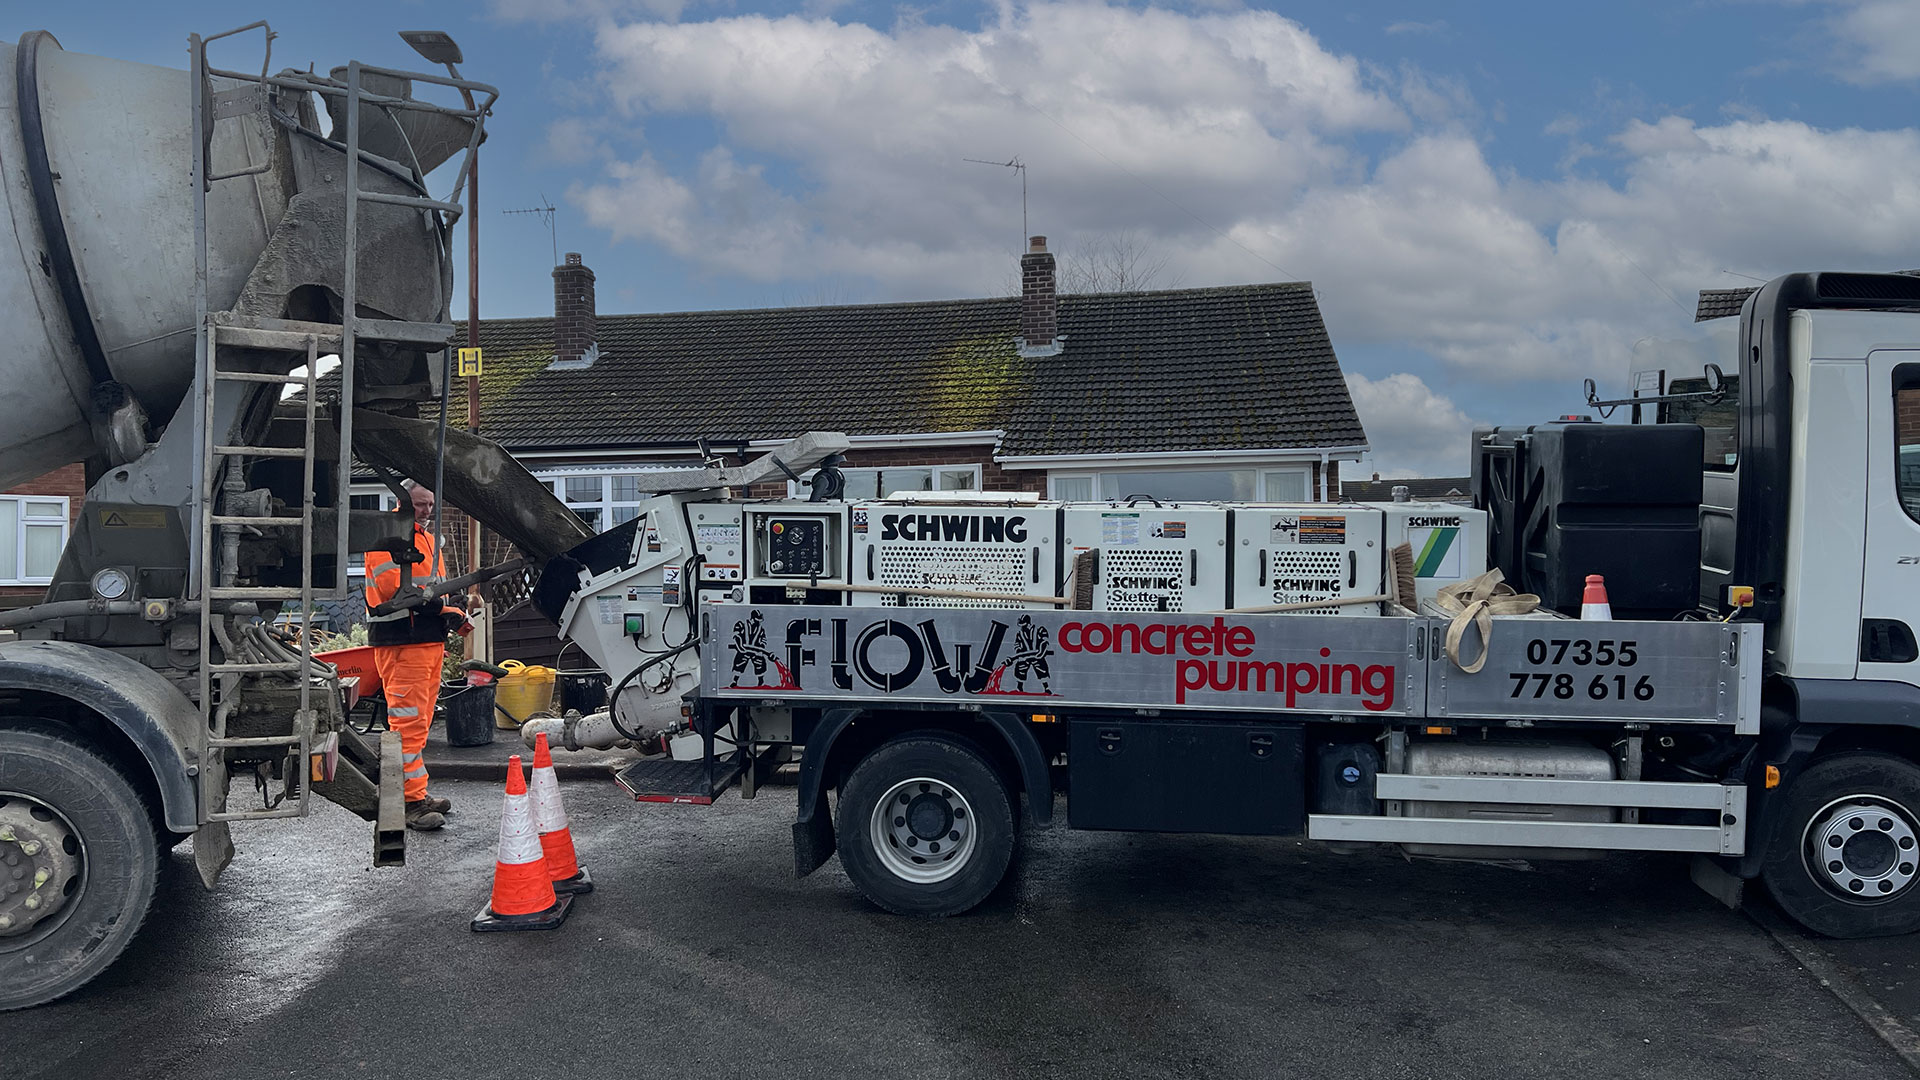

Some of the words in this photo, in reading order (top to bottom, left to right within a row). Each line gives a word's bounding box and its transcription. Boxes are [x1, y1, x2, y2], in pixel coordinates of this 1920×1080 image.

[462, 351, 479, 373] H
[881, 514, 1028, 543] SCHWING
[1408, 516, 1460, 527] SCHWING
[1112, 576, 1179, 590] SCHWING
[1273, 579, 1341, 592] SCHWING
[1112, 589, 1166, 603] Stette
[1058, 617, 1256, 657] concrete
[1527, 639, 1638, 667] 07355
[1176, 647, 1395, 711] pumping
[1509, 673, 1575, 700] 778
[1588, 674, 1655, 701] 616
